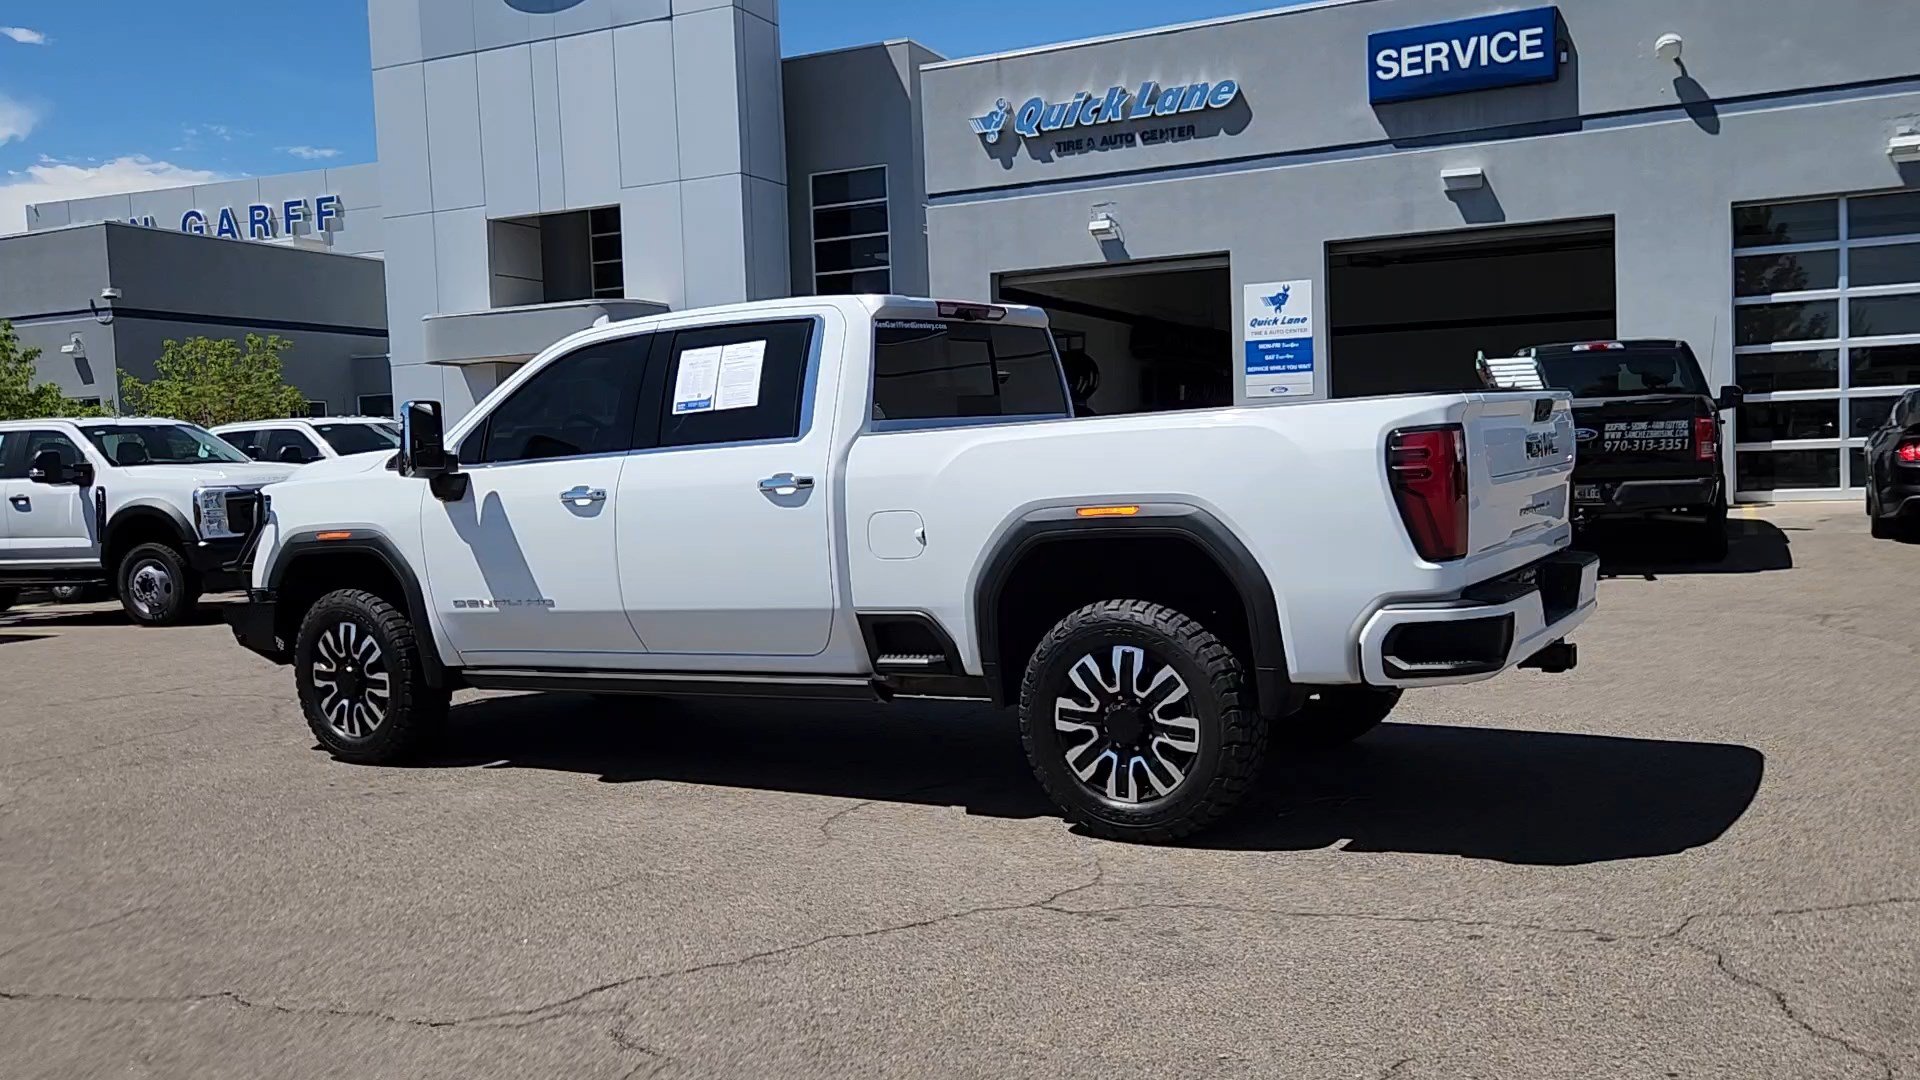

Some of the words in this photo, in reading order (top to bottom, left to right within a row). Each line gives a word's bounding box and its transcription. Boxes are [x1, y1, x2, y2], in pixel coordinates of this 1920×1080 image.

[1375, 27, 1545, 81] SERVICE
[1015, 86, 1131, 137] Quick
[1129, 80, 1239, 119] Lane
[1055, 139, 1083, 153] TIRE
[1100, 132, 1136, 148] AUTO
[1141, 124, 1196, 143] CENTER
[181, 195, 336, 241] GARFF
[1250, 317, 1279, 328] Quick
[1280, 315, 1308, 325] Lane
[1604, 439, 1688, 452] 970-313-3351
